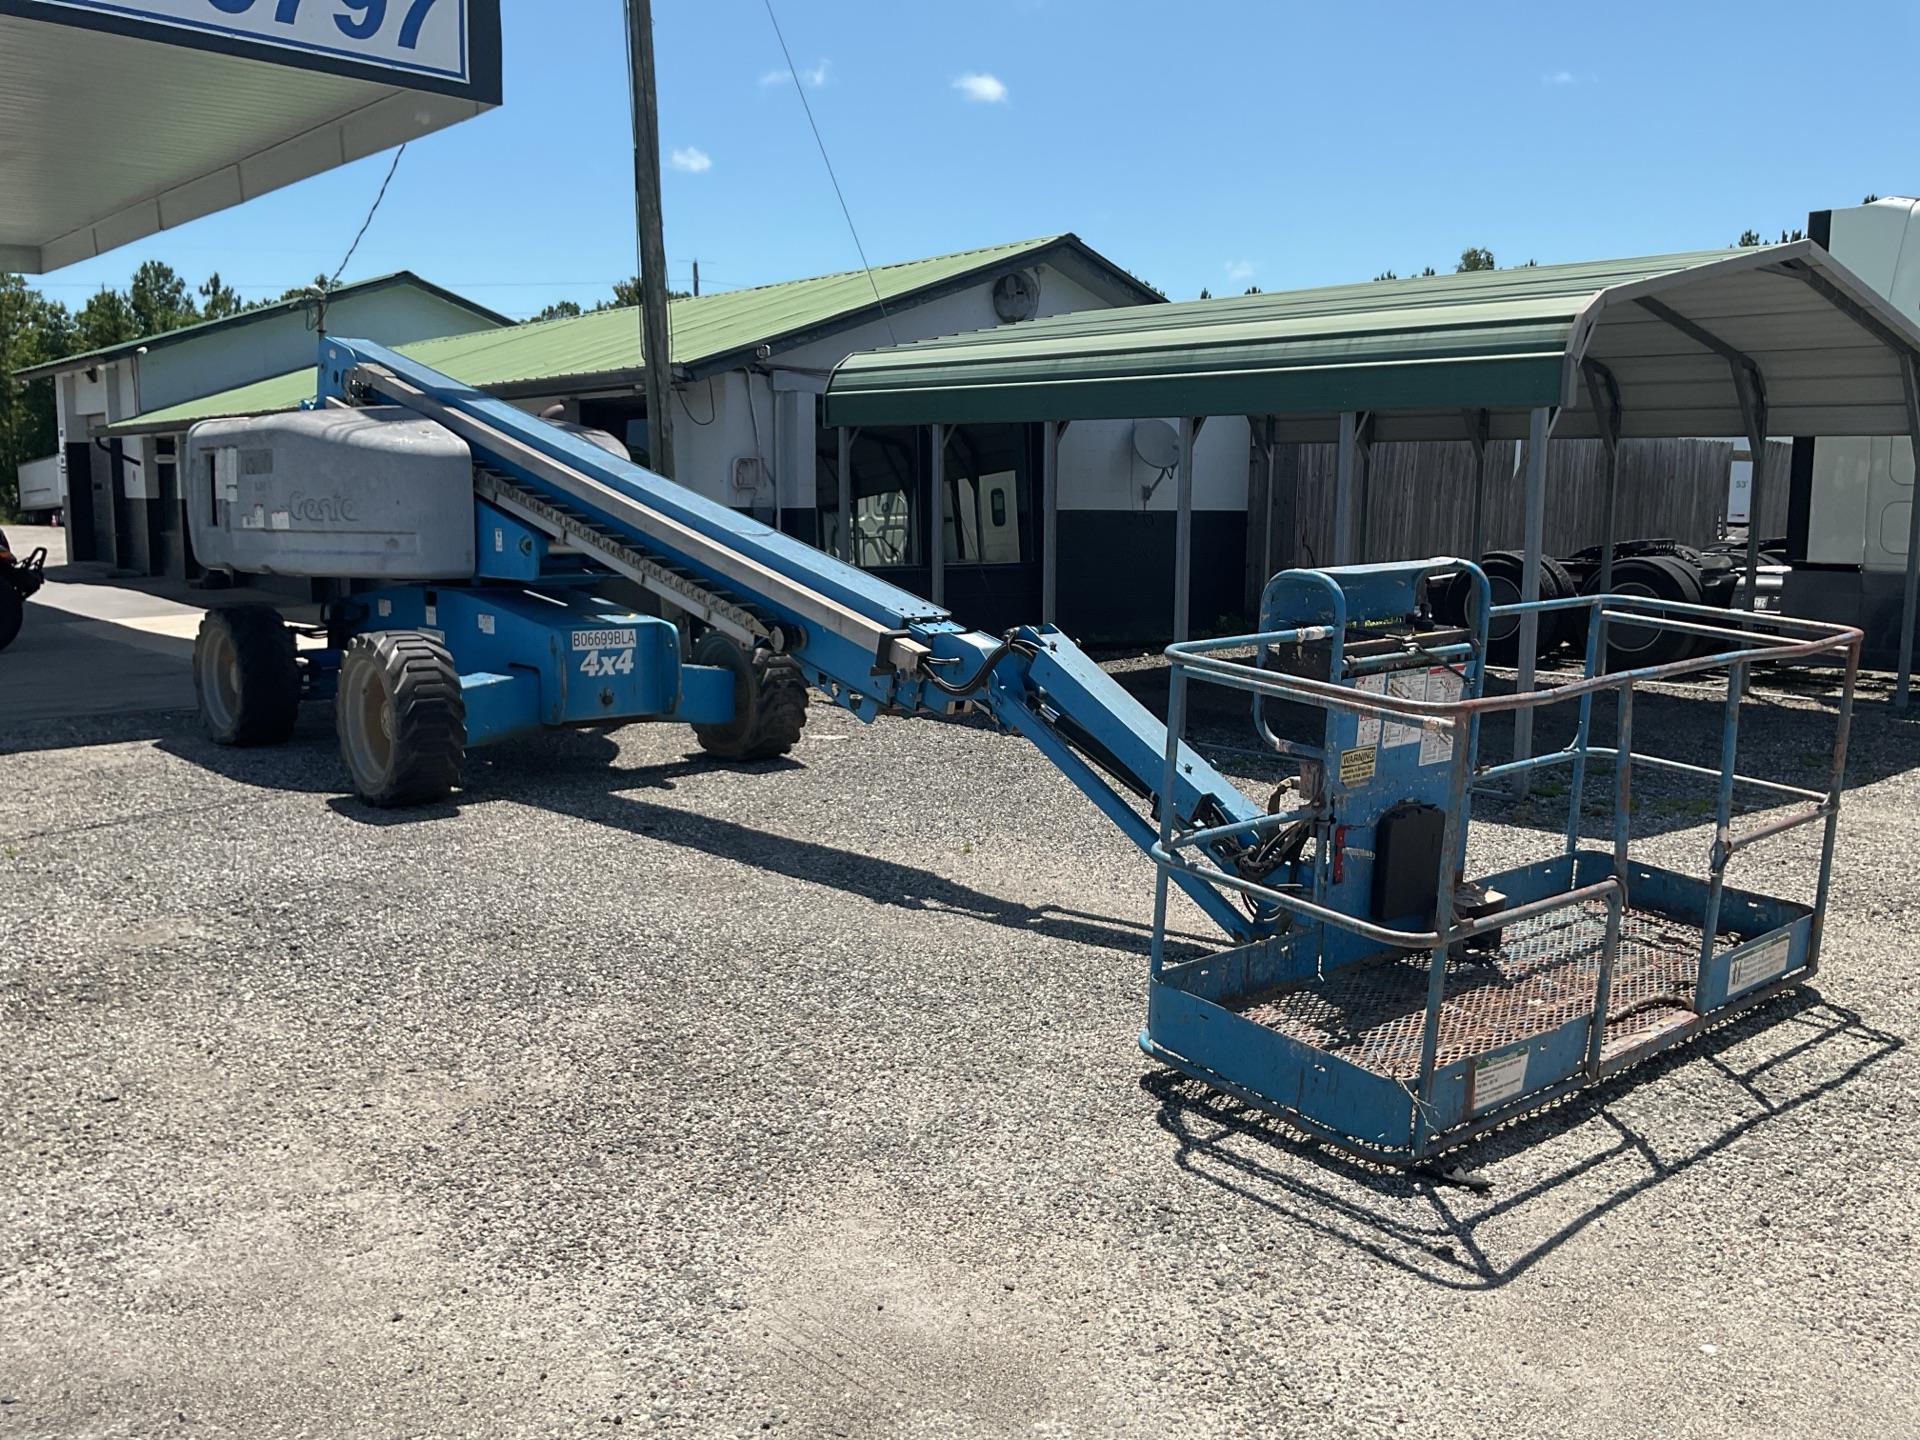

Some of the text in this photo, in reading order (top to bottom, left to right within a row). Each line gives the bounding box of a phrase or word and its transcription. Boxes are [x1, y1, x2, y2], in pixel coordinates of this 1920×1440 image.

[573, 631, 635, 647] B06699BLA
[580, 649, 634, 677] 4x4
[1343, 751, 1374, 765] WARNING
